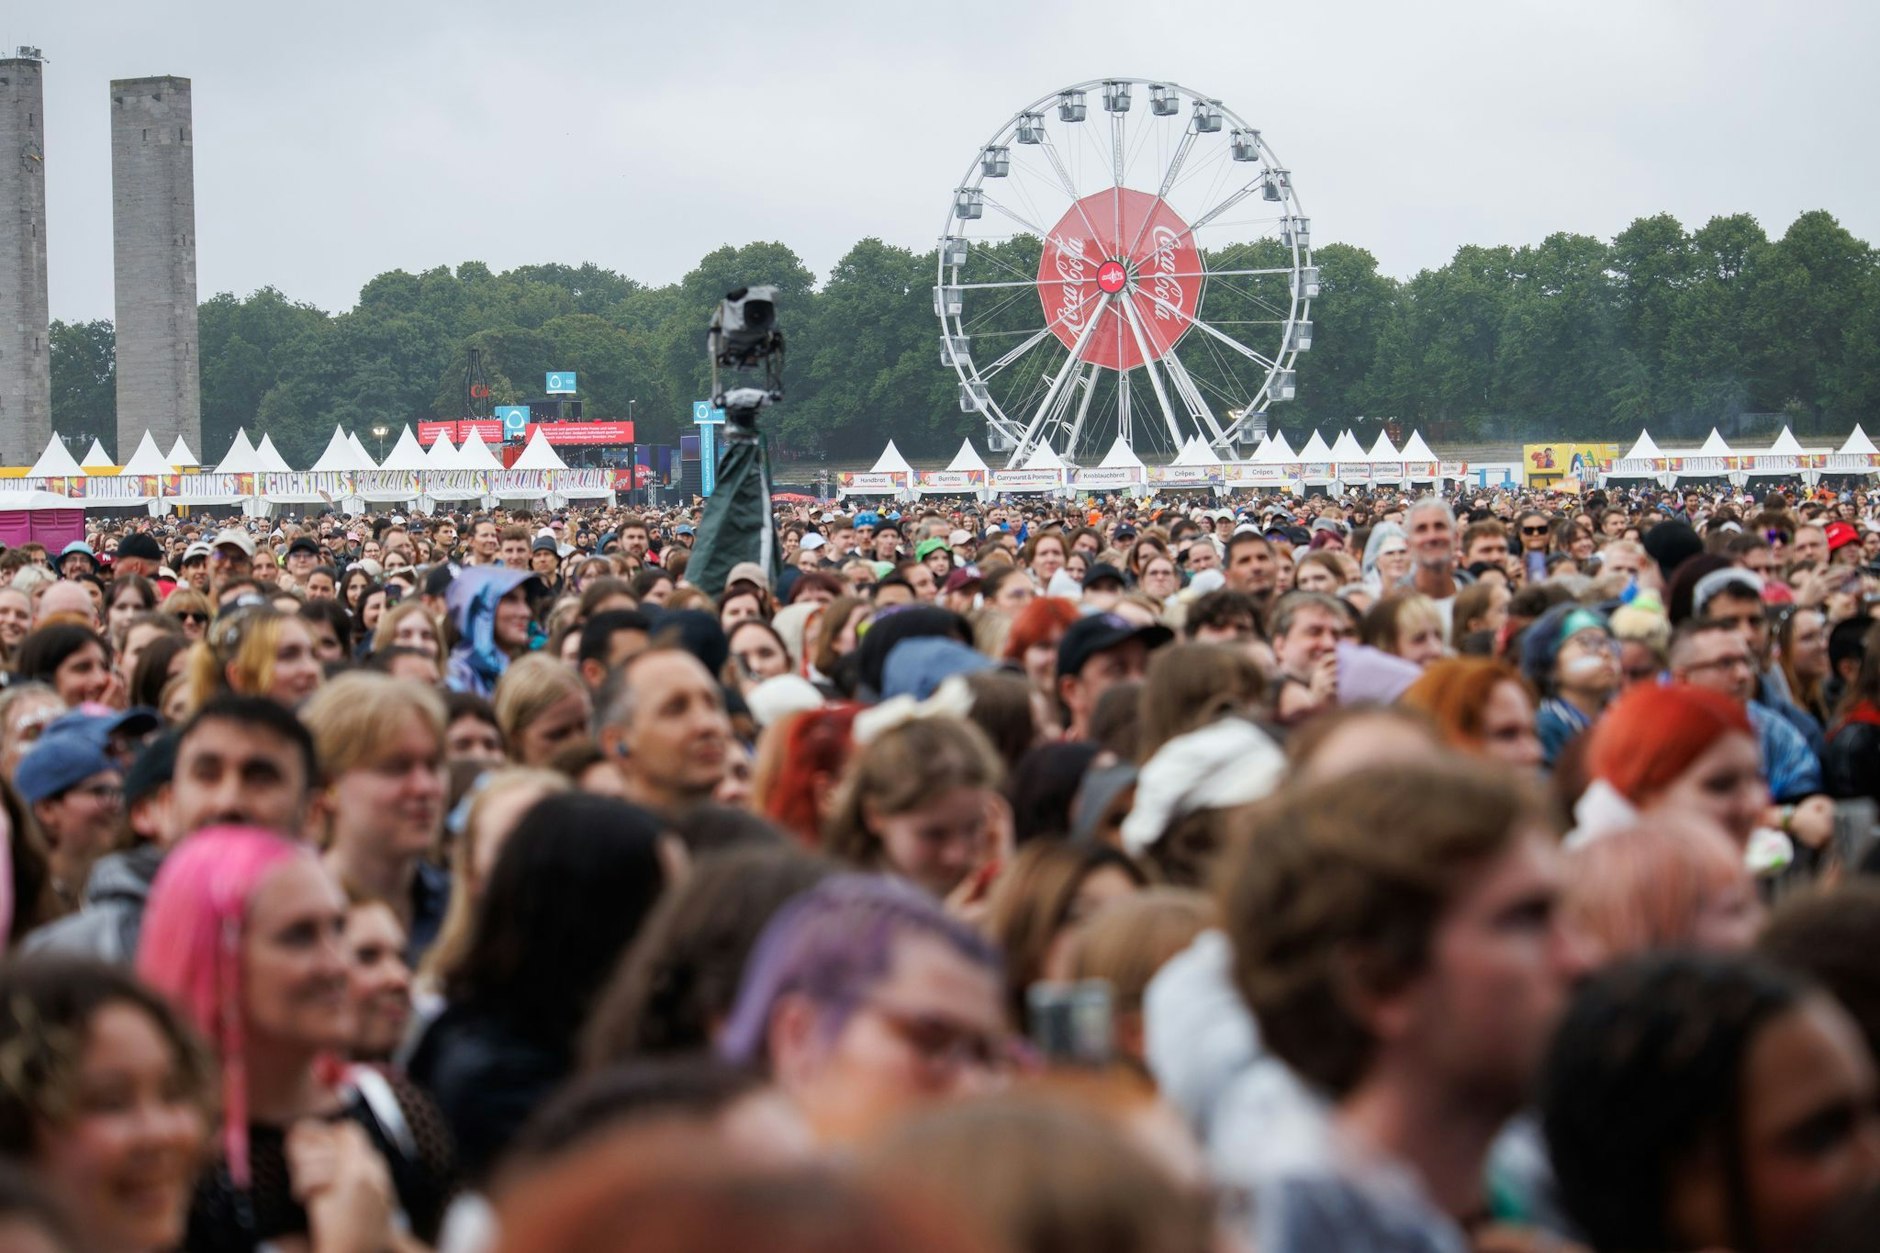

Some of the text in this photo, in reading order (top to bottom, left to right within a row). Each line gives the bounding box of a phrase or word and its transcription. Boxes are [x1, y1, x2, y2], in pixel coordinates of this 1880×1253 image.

[1614, 458, 1653, 472] DRINKS
[1684, 457, 1724, 471] DRINKS
[1758, 456, 1796, 470] DRINKS
[1828, 454, 1868, 468] DRINKS
[87, 476, 140, 498] DRINKS
[182, 474, 235, 496] DRINKS
[266, 471, 352, 494] COCKTAILS
[356, 470, 418, 492] COCKTAILS
[425, 470, 486, 490] COCKTAILS
[492, 469, 547, 490] COCKTAILS
[558, 469, 611, 490] COCKTAILS
[996, 474, 1027, 482] Currywurst
